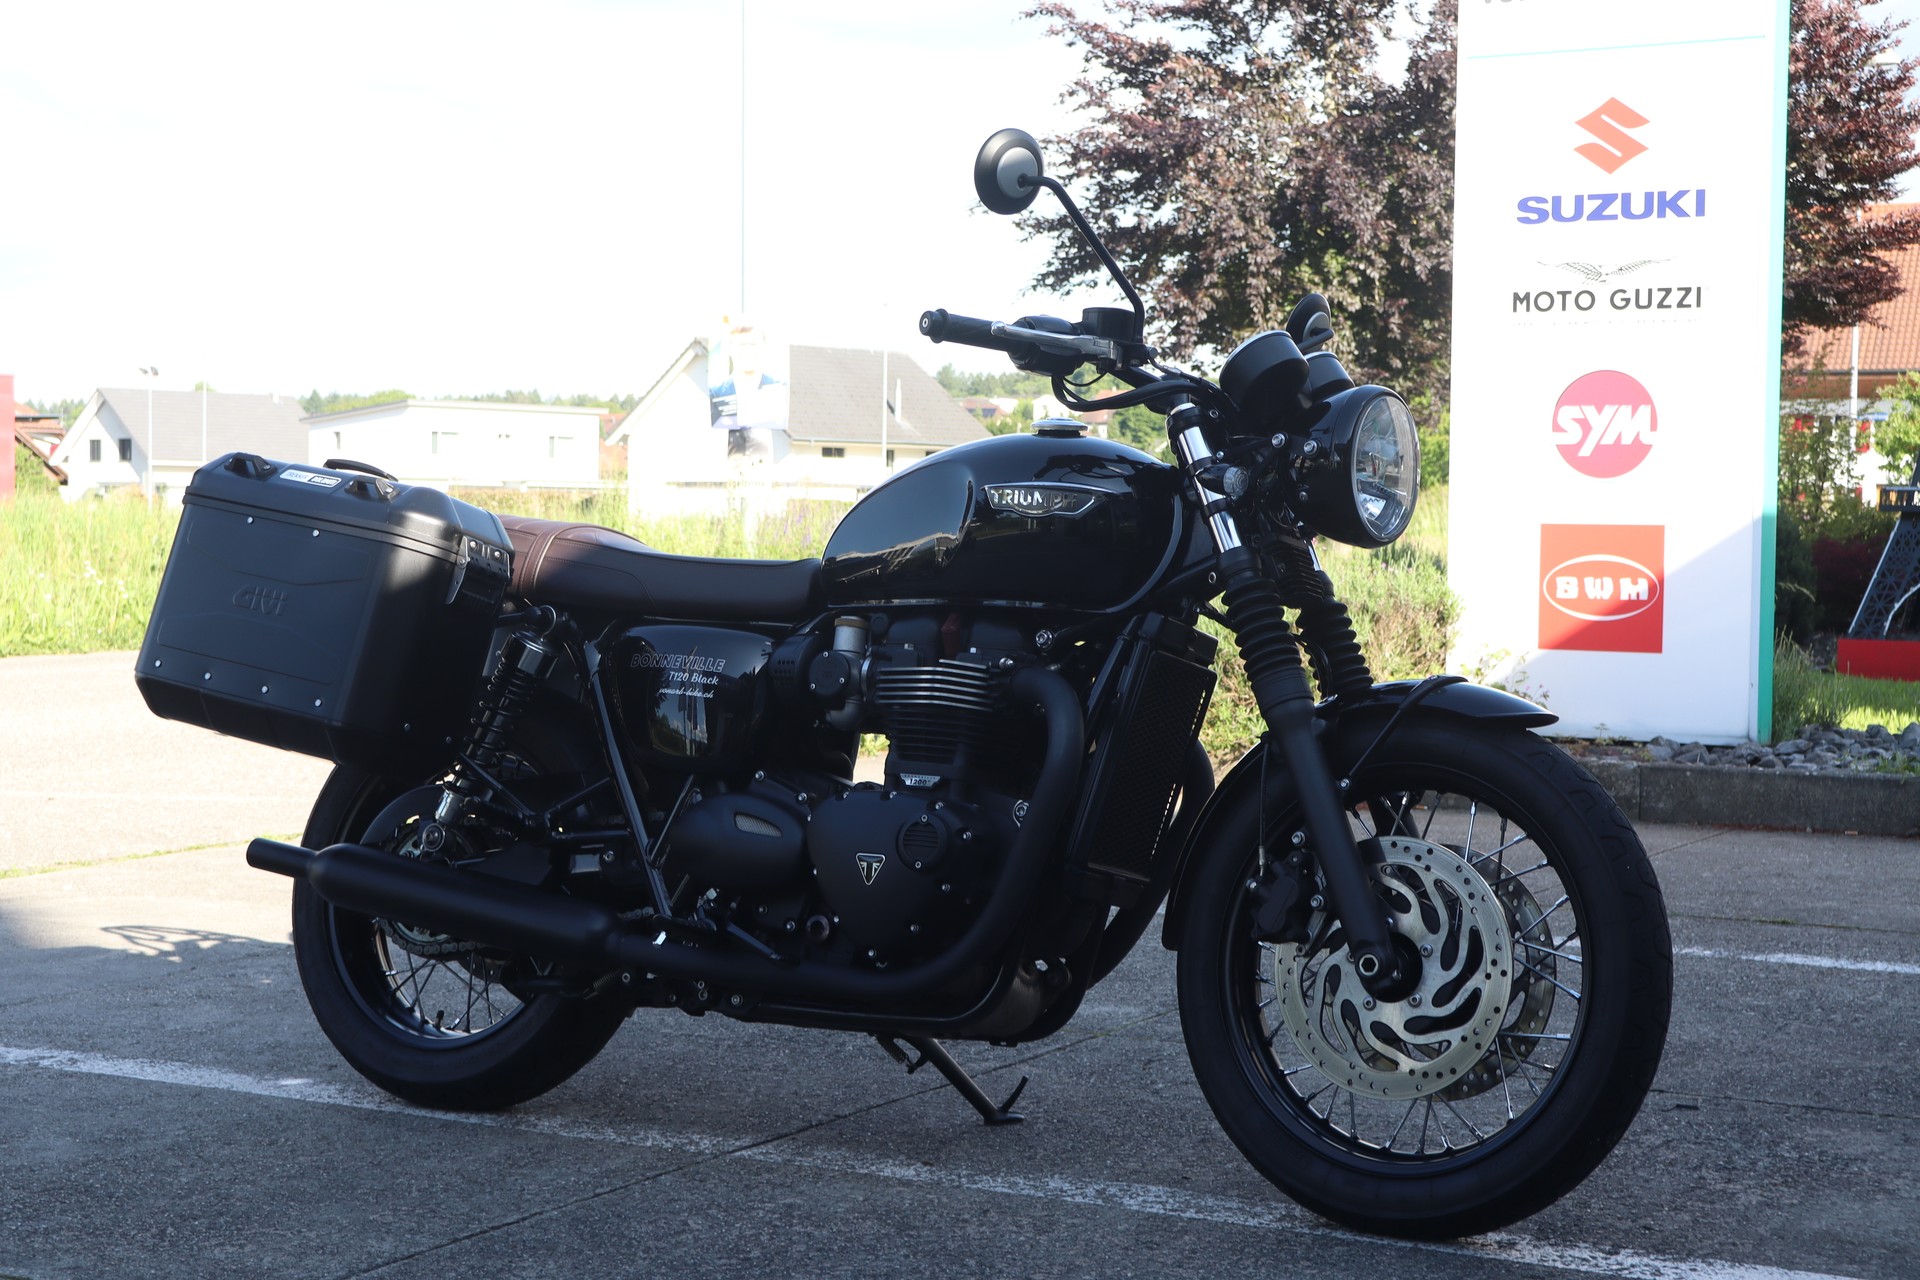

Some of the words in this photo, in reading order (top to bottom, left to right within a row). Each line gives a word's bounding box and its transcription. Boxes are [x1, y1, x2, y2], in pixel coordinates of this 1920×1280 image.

[1517, 189, 1706, 225] SUZUKI
[1512, 290, 1596, 313] MOTO
[1609, 287, 1702, 310] GUZZI
[1552, 404, 1658, 457] SYM
[232, 584, 287, 616] GIVI
[1556, 576, 1649, 601] BWM
[631, 653, 726, 673] BONNEVILLE
[669, 671, 689, 682] T120
[690, 673, 719, 685] Black
